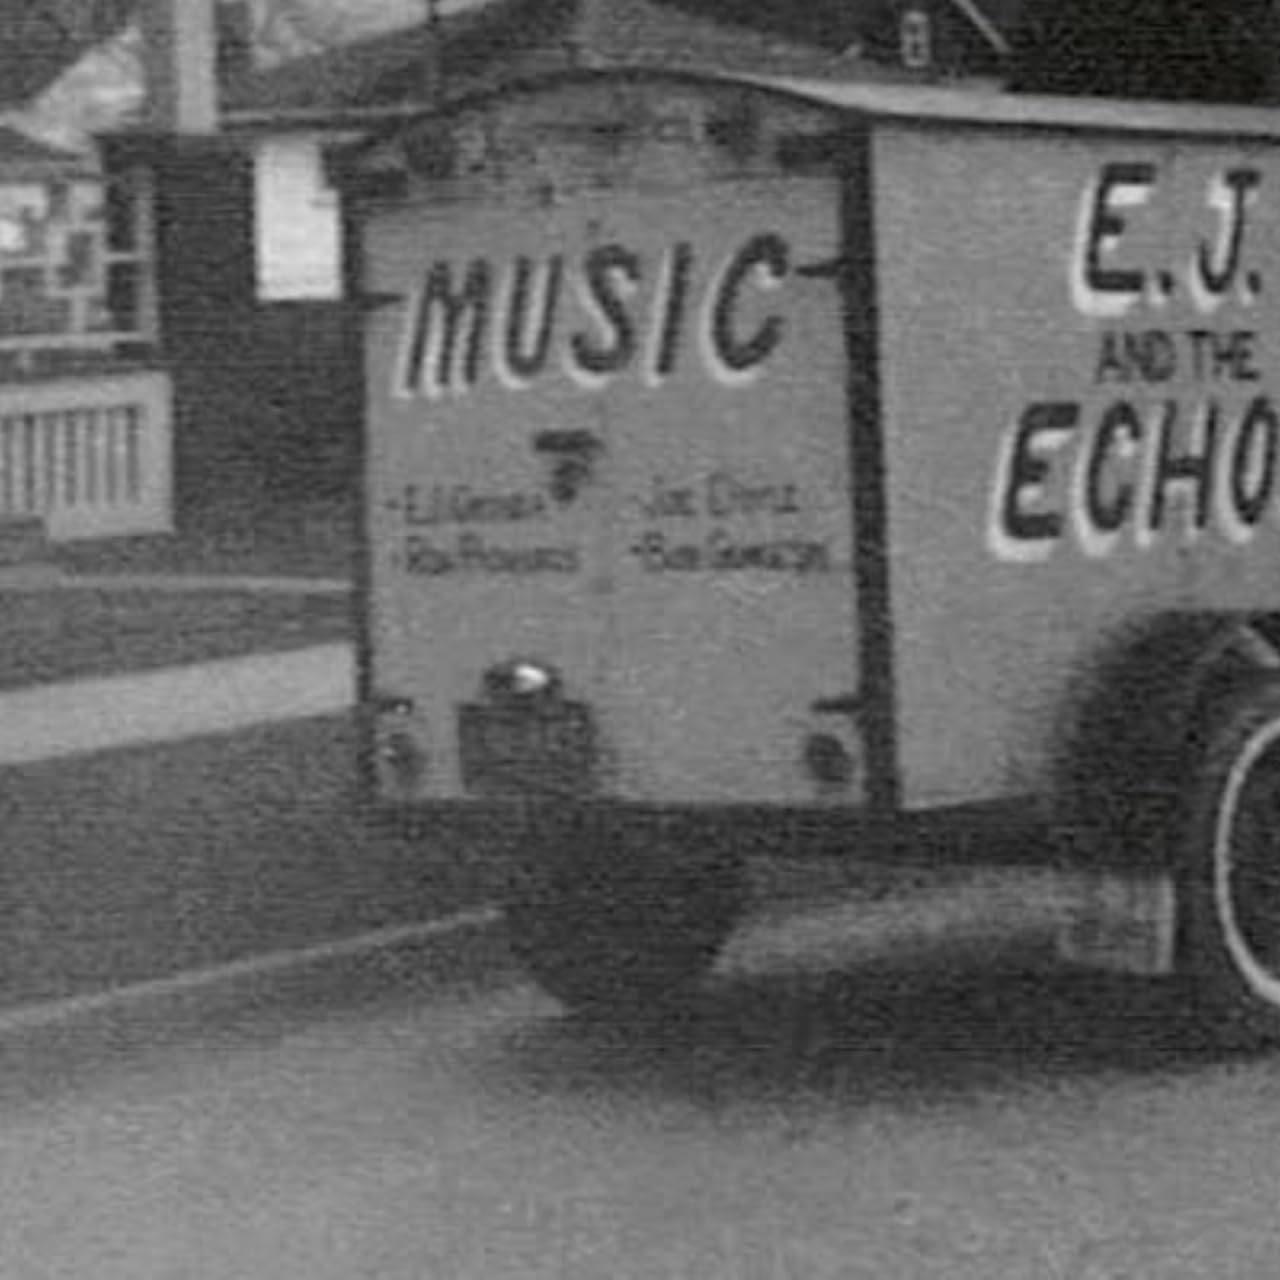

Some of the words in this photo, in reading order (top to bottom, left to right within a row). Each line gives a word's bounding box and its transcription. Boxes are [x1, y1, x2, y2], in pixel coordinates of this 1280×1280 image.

[395, 231, 792, 396] MUSIC
[1098, 330, 1177, 383] AND
[1186, 329, 1262, 381] THE
